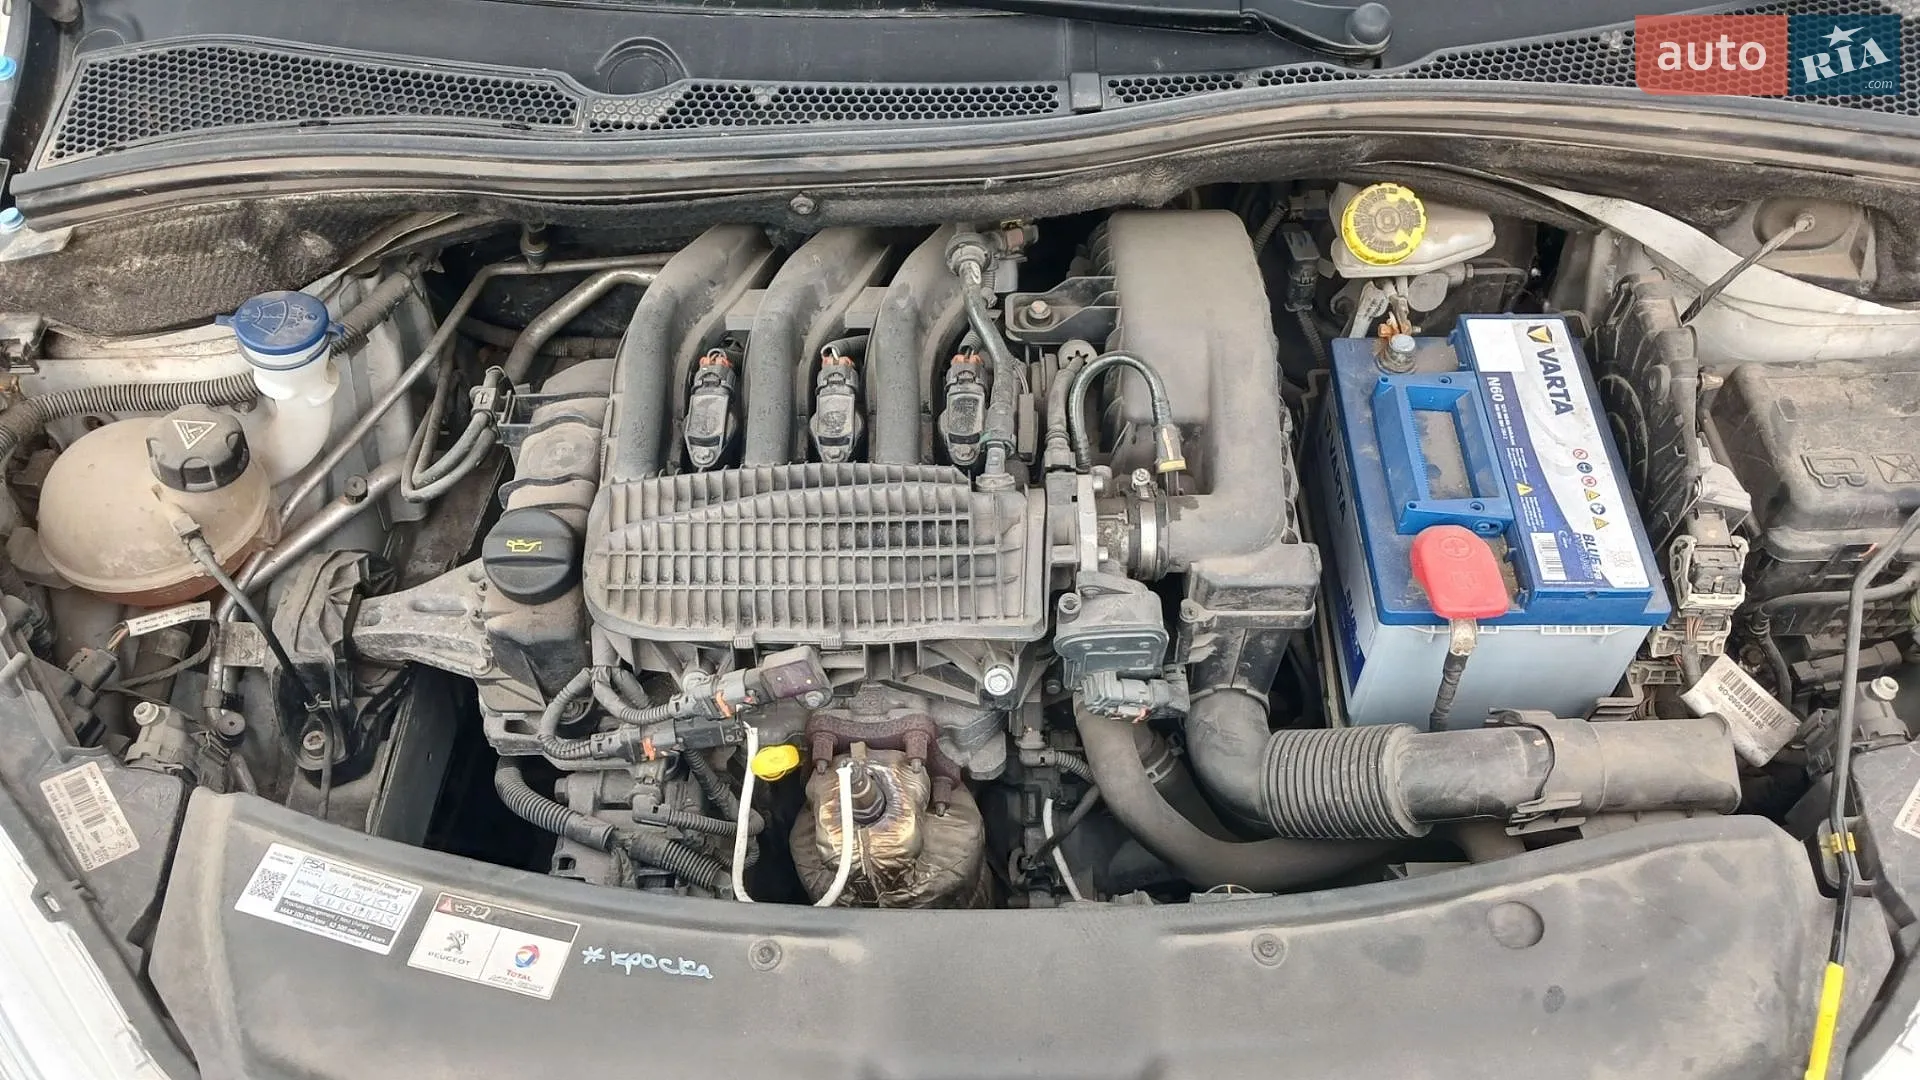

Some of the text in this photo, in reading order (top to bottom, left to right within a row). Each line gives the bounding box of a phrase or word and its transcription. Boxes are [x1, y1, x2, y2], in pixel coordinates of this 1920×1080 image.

[1537, 347, 1574, 415] VARTA
[1486, 377, 1505, 402] N60
[1582, 533, 1602, 567] BLUE
[302, 856, 326, 871] PSA
[280, 906, 294, 917] MAX
[428, 951, 472, 967] PEUGEOT
[506, 968, 533, 982] TOTAL
